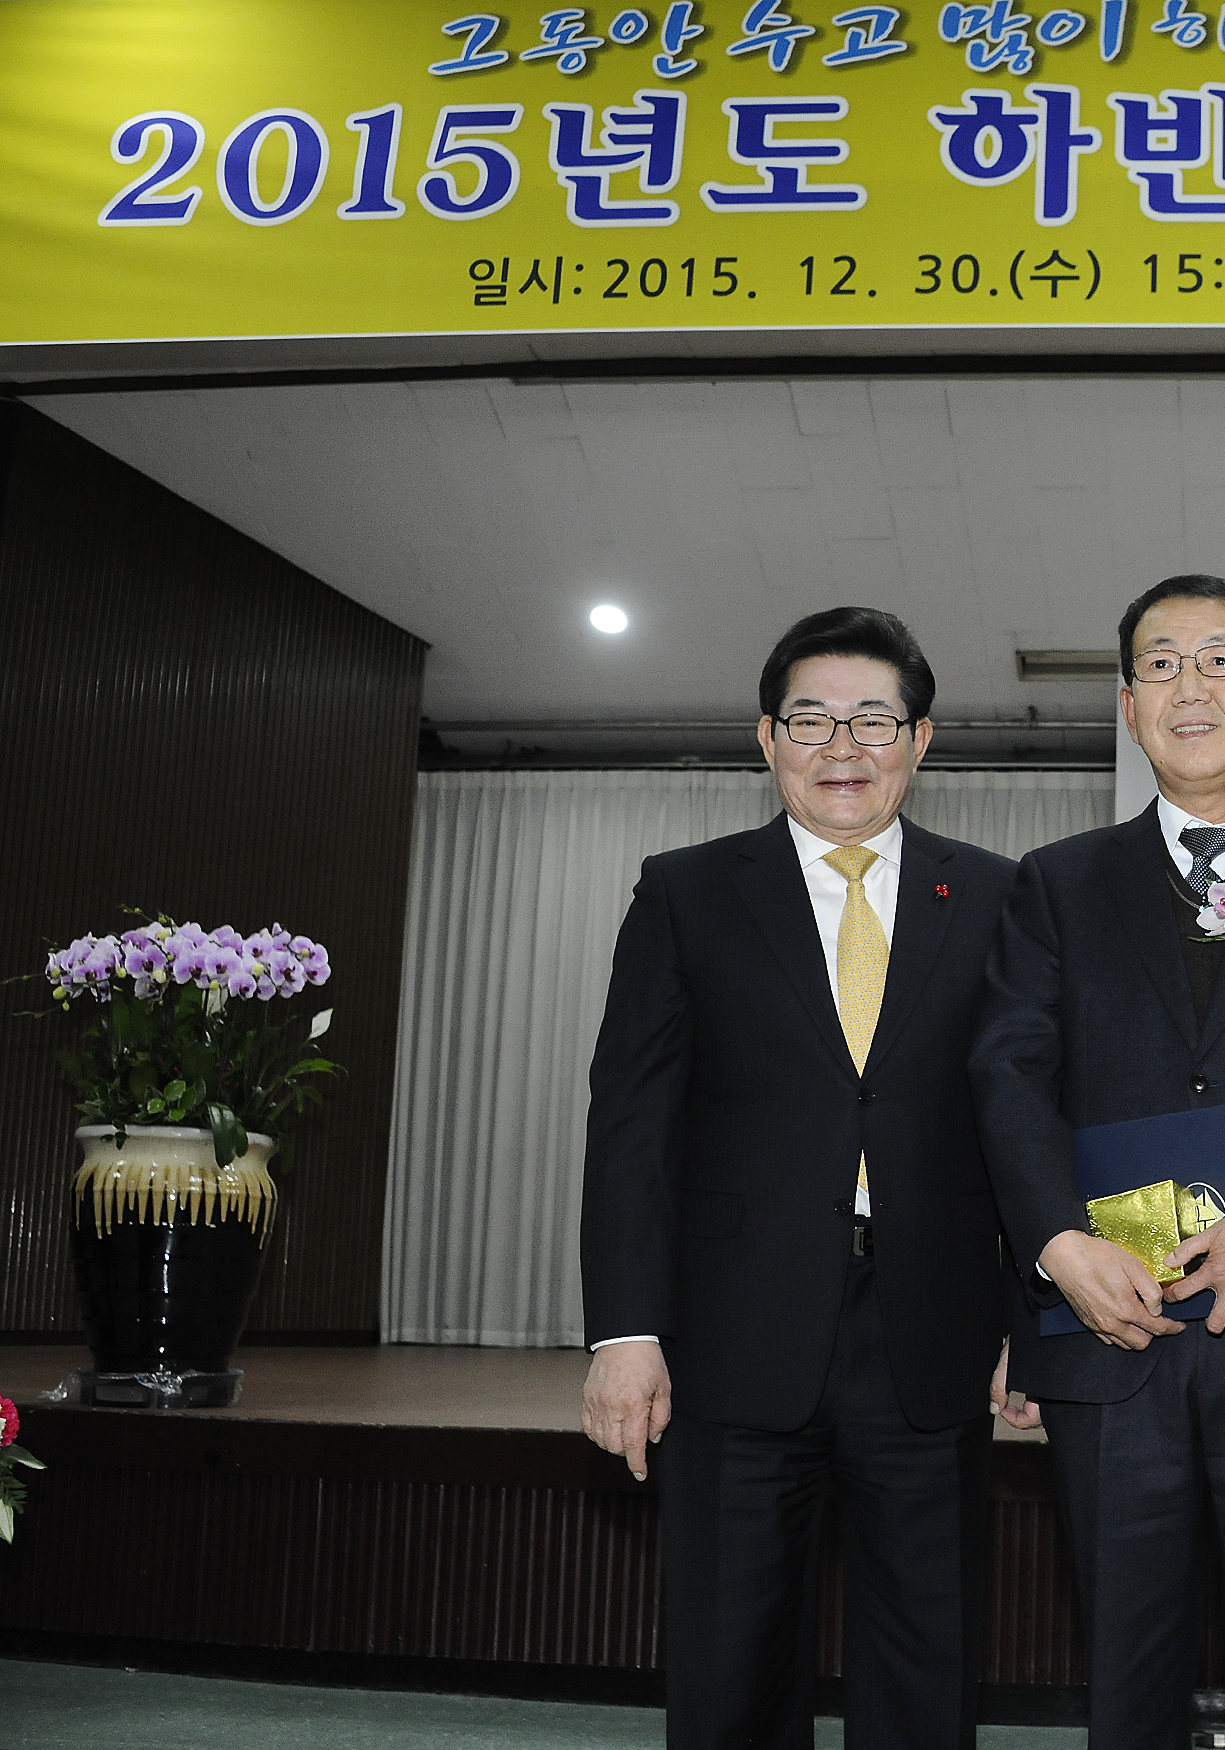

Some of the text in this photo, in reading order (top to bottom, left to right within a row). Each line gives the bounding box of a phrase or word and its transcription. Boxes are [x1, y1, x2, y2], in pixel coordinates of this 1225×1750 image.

[428, 0, 706, 79] 그동안
[726, 0, 908, 72] 수고
[938, 0, 1126, 75] 많이
[97, 89, 867, 228] 2015년도
[468, 255, 585, 306] 일시:
[602, 256, 758, 299] 2015.
[799, 254, 878, 298] 12.
